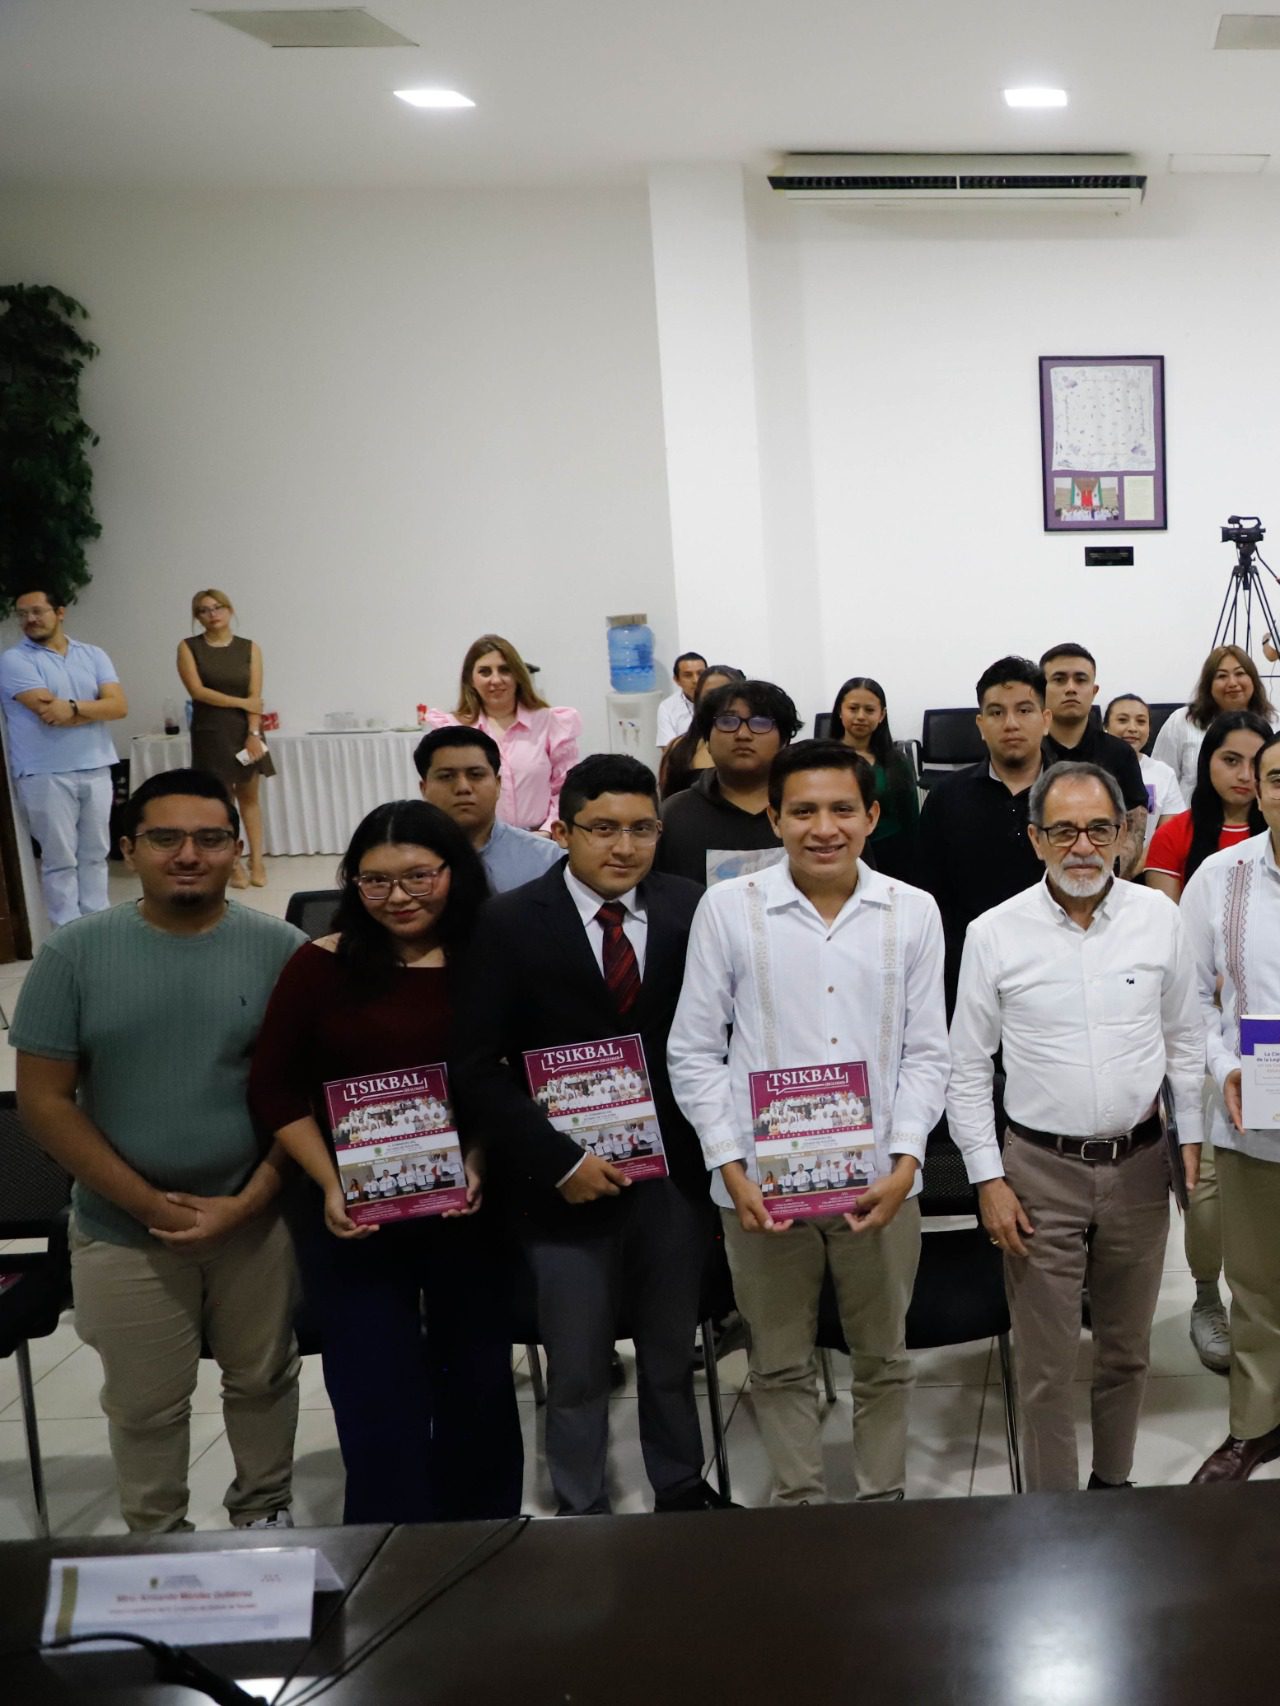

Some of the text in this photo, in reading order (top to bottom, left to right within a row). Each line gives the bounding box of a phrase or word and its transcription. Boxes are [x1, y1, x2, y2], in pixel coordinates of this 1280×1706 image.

[543, 1043, 619, 1065] TSIKBAL
[346, 1073, 424, 1096] TSIKBAL
[770, 1067, 845, 1087] TSIKBAL
